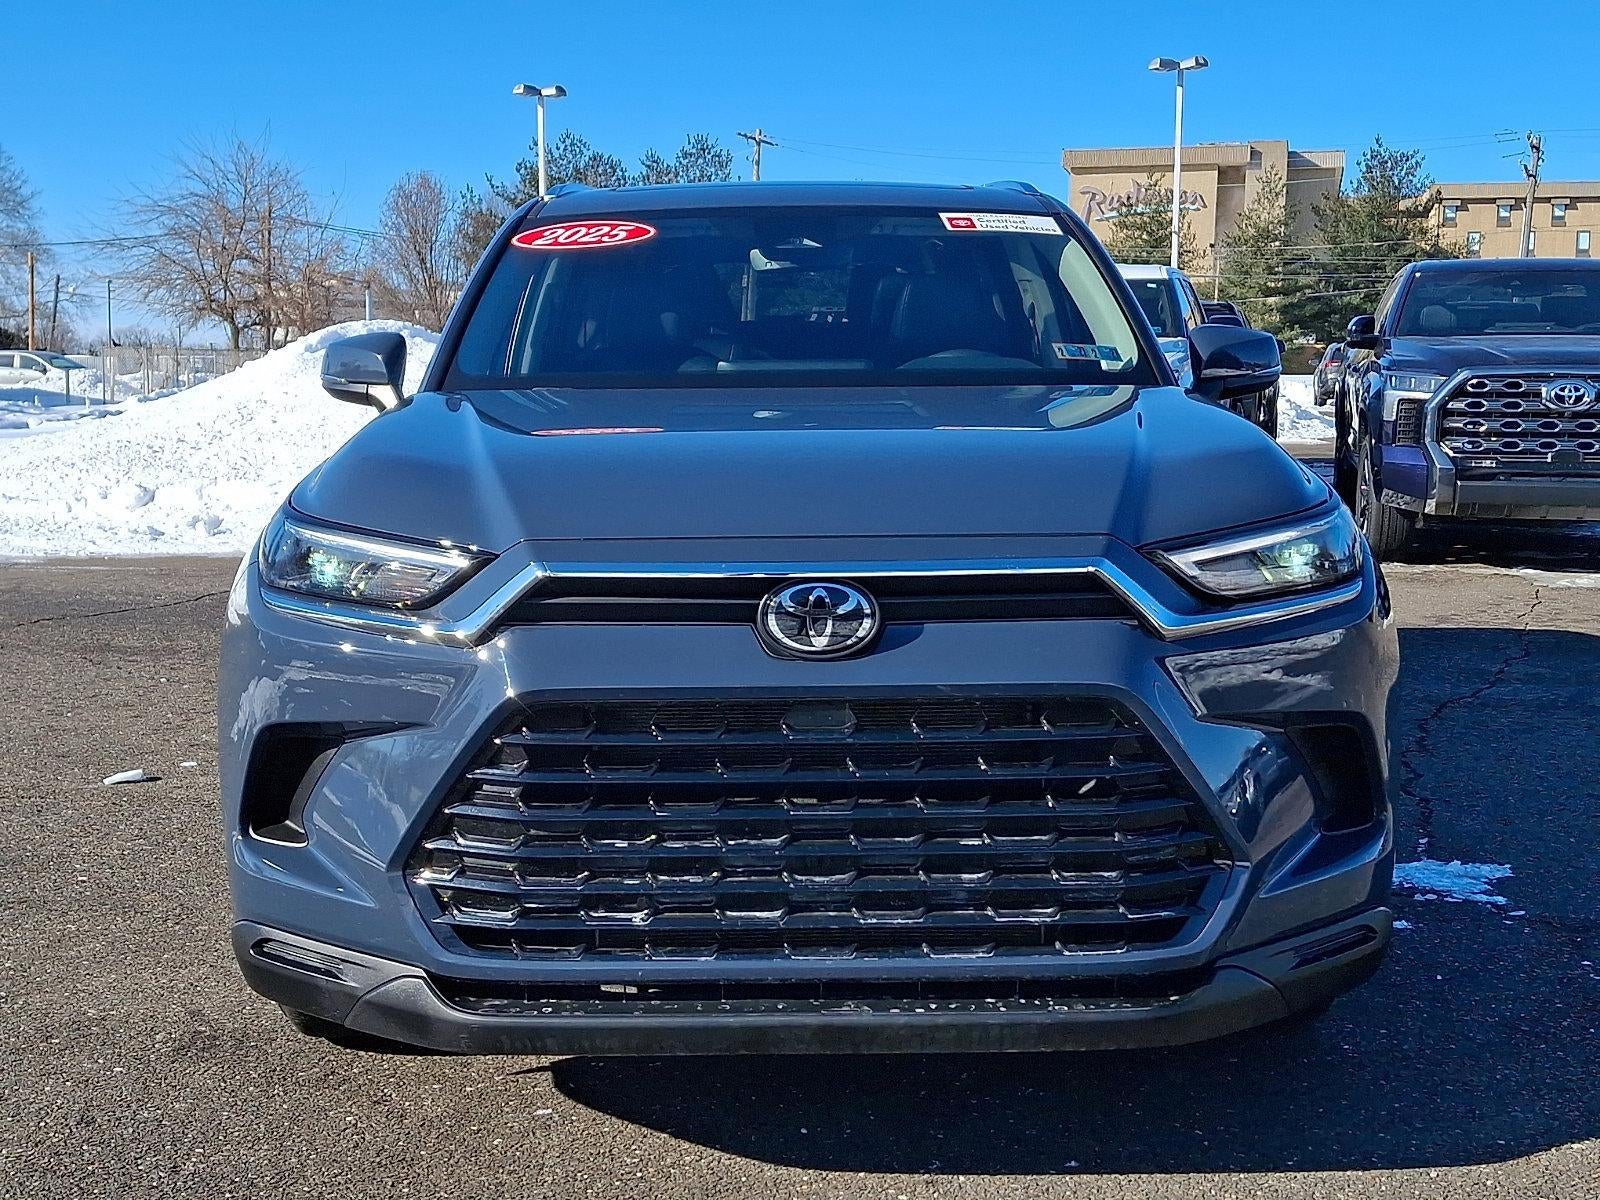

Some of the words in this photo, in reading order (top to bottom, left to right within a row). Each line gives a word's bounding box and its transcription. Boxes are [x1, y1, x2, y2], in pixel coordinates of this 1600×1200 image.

[1079, 178, 1208, 225] Radion
[977, 217, 1027, 225] Certified
[532, 226, 636, 246] 2025
[1010, 225, 1058, 233] Vehicles
